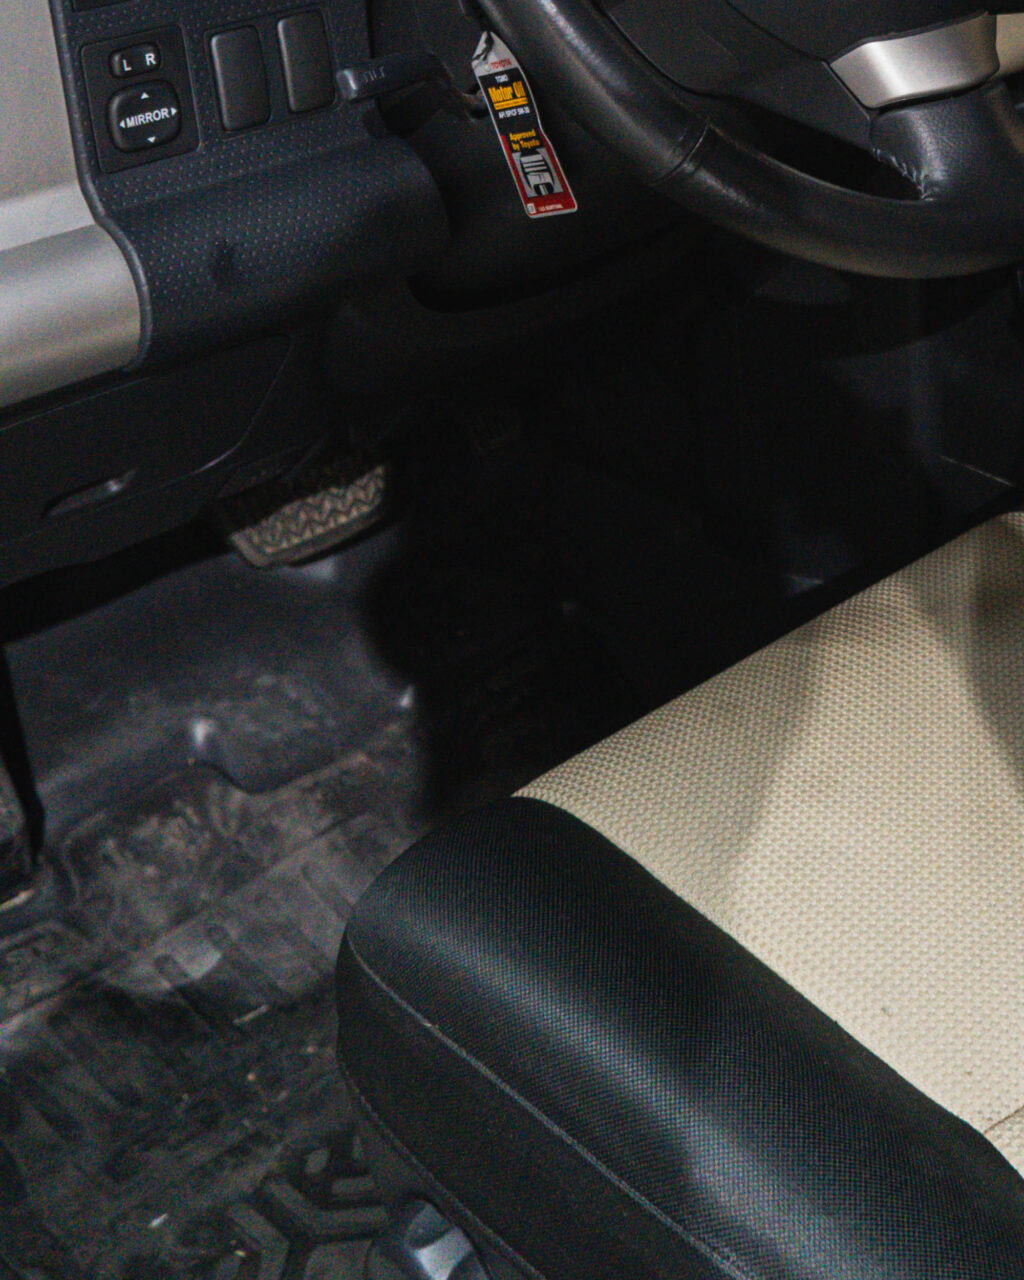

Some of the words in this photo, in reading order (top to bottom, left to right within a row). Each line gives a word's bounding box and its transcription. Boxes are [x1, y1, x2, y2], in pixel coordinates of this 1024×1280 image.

[122, 59, 132, 72] L
[145, 53, 157, 66] R
[488, 85, 513, 104] Motor
[126, 107, 170, 128] MIRROR
[509, 129, 536, 141] Approved
[520, 138, 540, 149] Toyota
